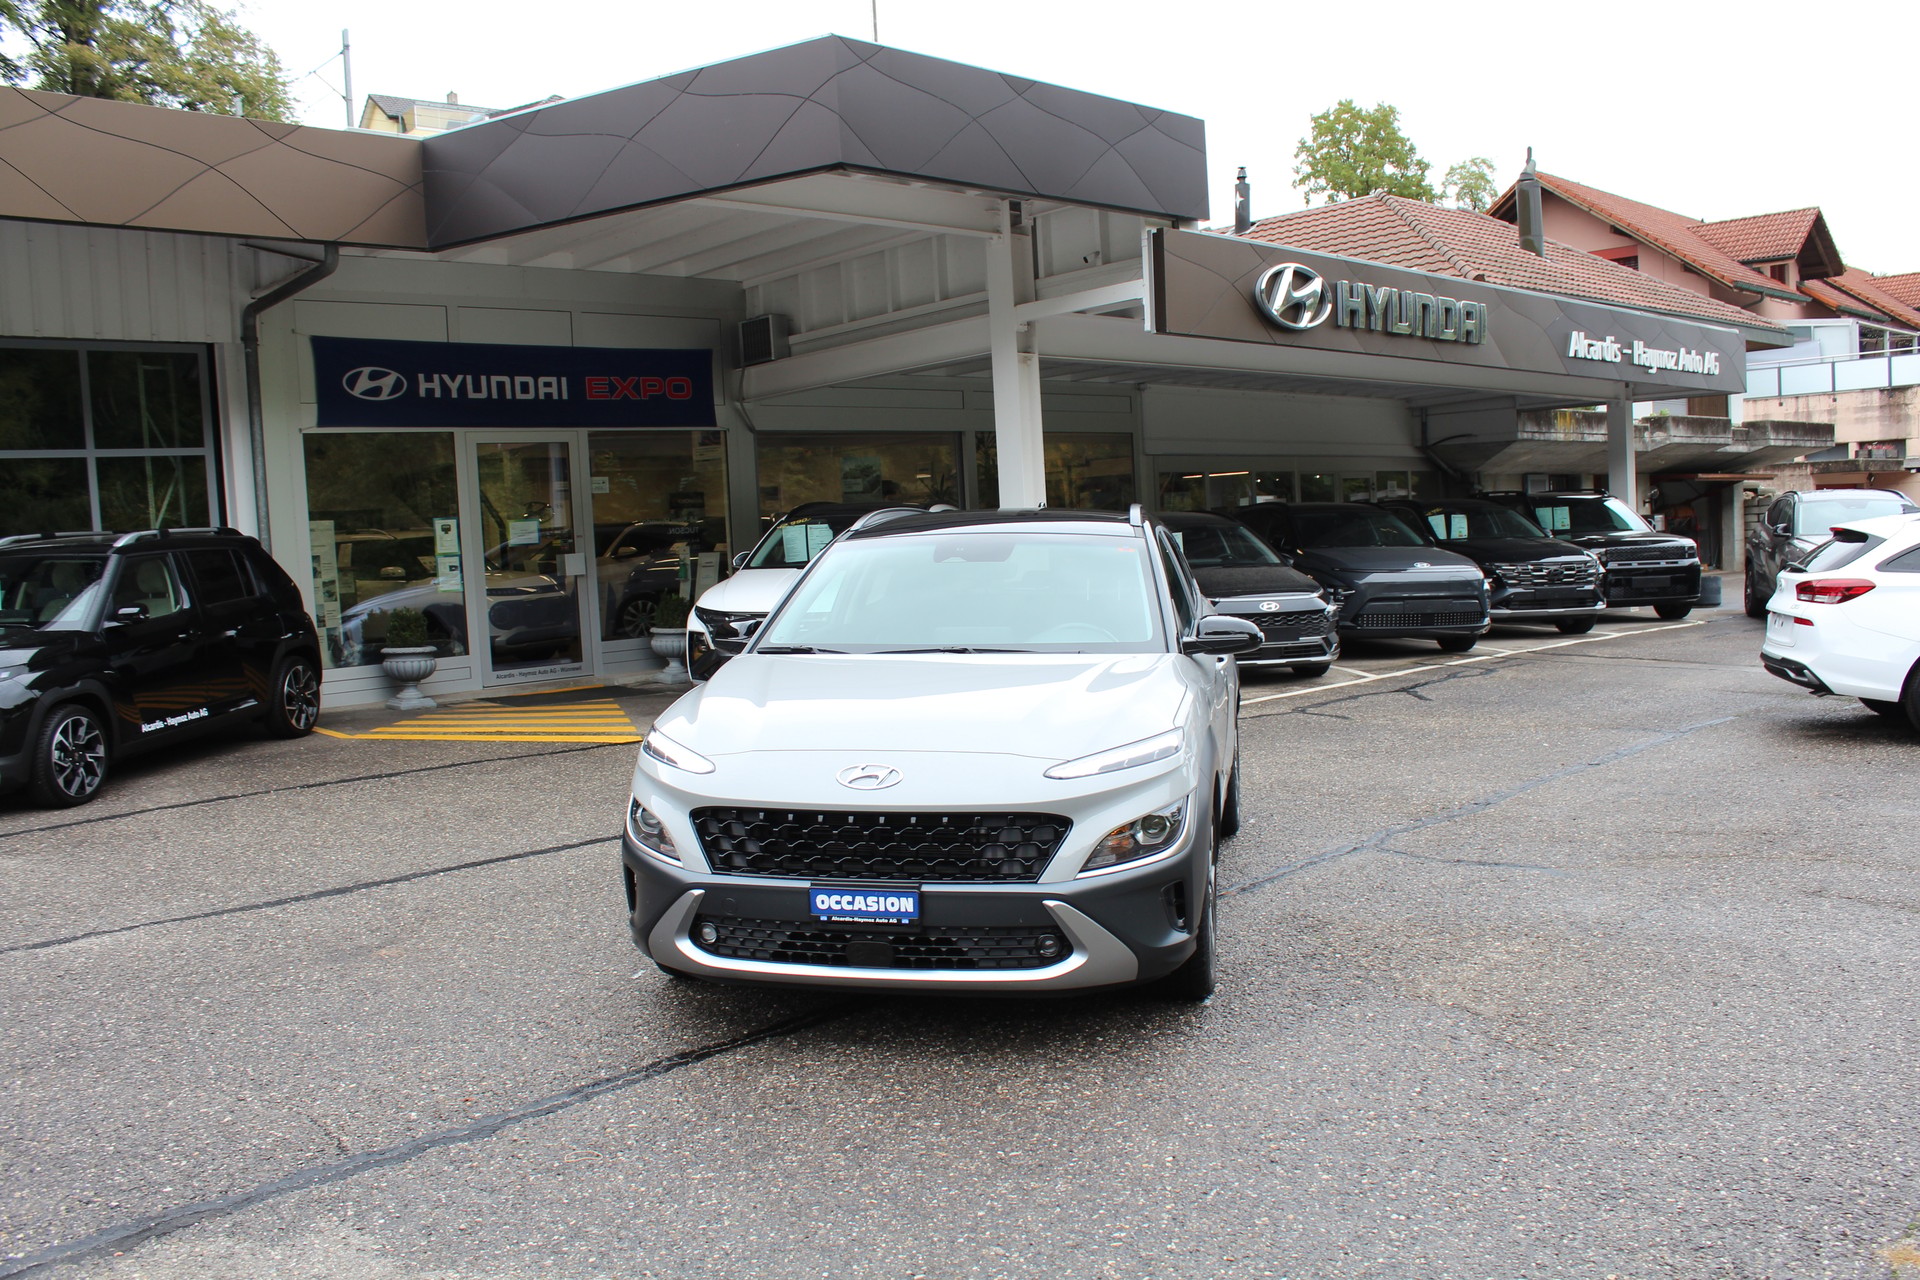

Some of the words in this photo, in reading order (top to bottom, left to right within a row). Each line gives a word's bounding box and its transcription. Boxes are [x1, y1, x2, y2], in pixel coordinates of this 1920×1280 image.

[1336, 280, 1487, 345] HYUNDAI
[1568, 331, 1621, 363] Alcardis
[1632, 340, 1678, 374] Haymoz
[1678, 347, 1703, 373] Auto
[1703, 351, 1720, 375] AG
[418, 373, 568, 400] HYUNDAI
[585, 376, 692, 400] EXPO
[187, 711, 201, 720] Auto
[199, 707, 209, 717] AG
[815, 894, 914, 912] OCCASION
